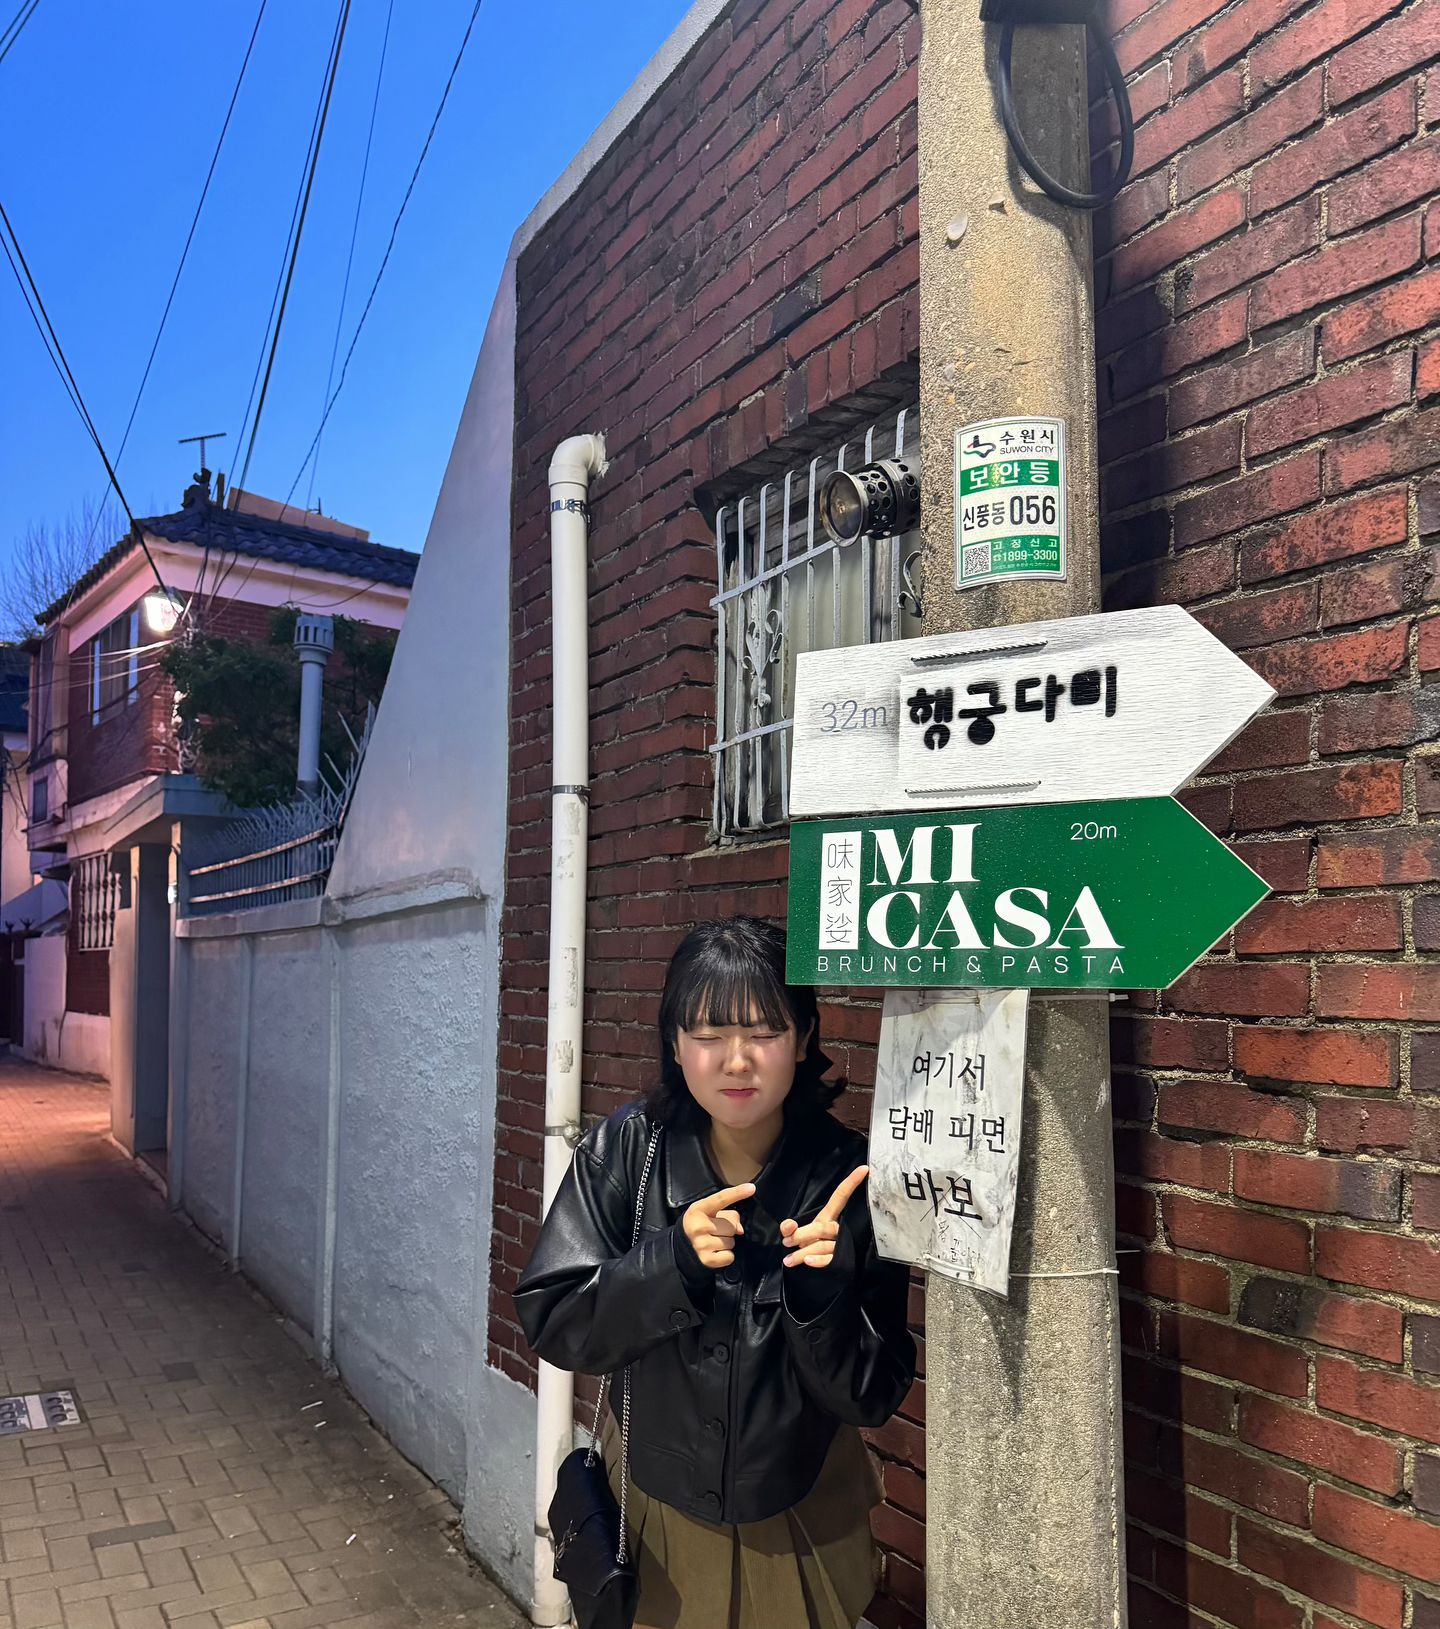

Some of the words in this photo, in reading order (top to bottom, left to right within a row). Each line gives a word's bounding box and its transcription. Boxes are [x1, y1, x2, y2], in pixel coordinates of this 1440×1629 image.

[1000, 429, 1055, 446] 수원시
[1000, 446, 1033, 455] SUWON
[1035, 446, 1054, 454] CITY
[969, 461, 1050, 490] 보안등
[963, 501, 1006, 531] 신풍동
[1009, 495, 1056, 525] 056
[1002, 550, 1058, 562] 1899-3300
[820, 699, 889, 733] 32m
[907, 666, 1118, 750] 행궁다미
[1070, 822, 1118, 840] 20m
[867, 823, 982, 886] MI
[866, 886, 1125, 950] CASA
[817, 955, 947, 973] BRUNCH
[967, 955, 982, 973] &
[1002, 955, 1125, 974] PASTA
[912, 1051, 986, 1091] 여기서
[888, 1106, 933, 1145] 담배
[948, 1113, 1005, 1153] 피면
[902, 1168, 982, 1221] 바보
